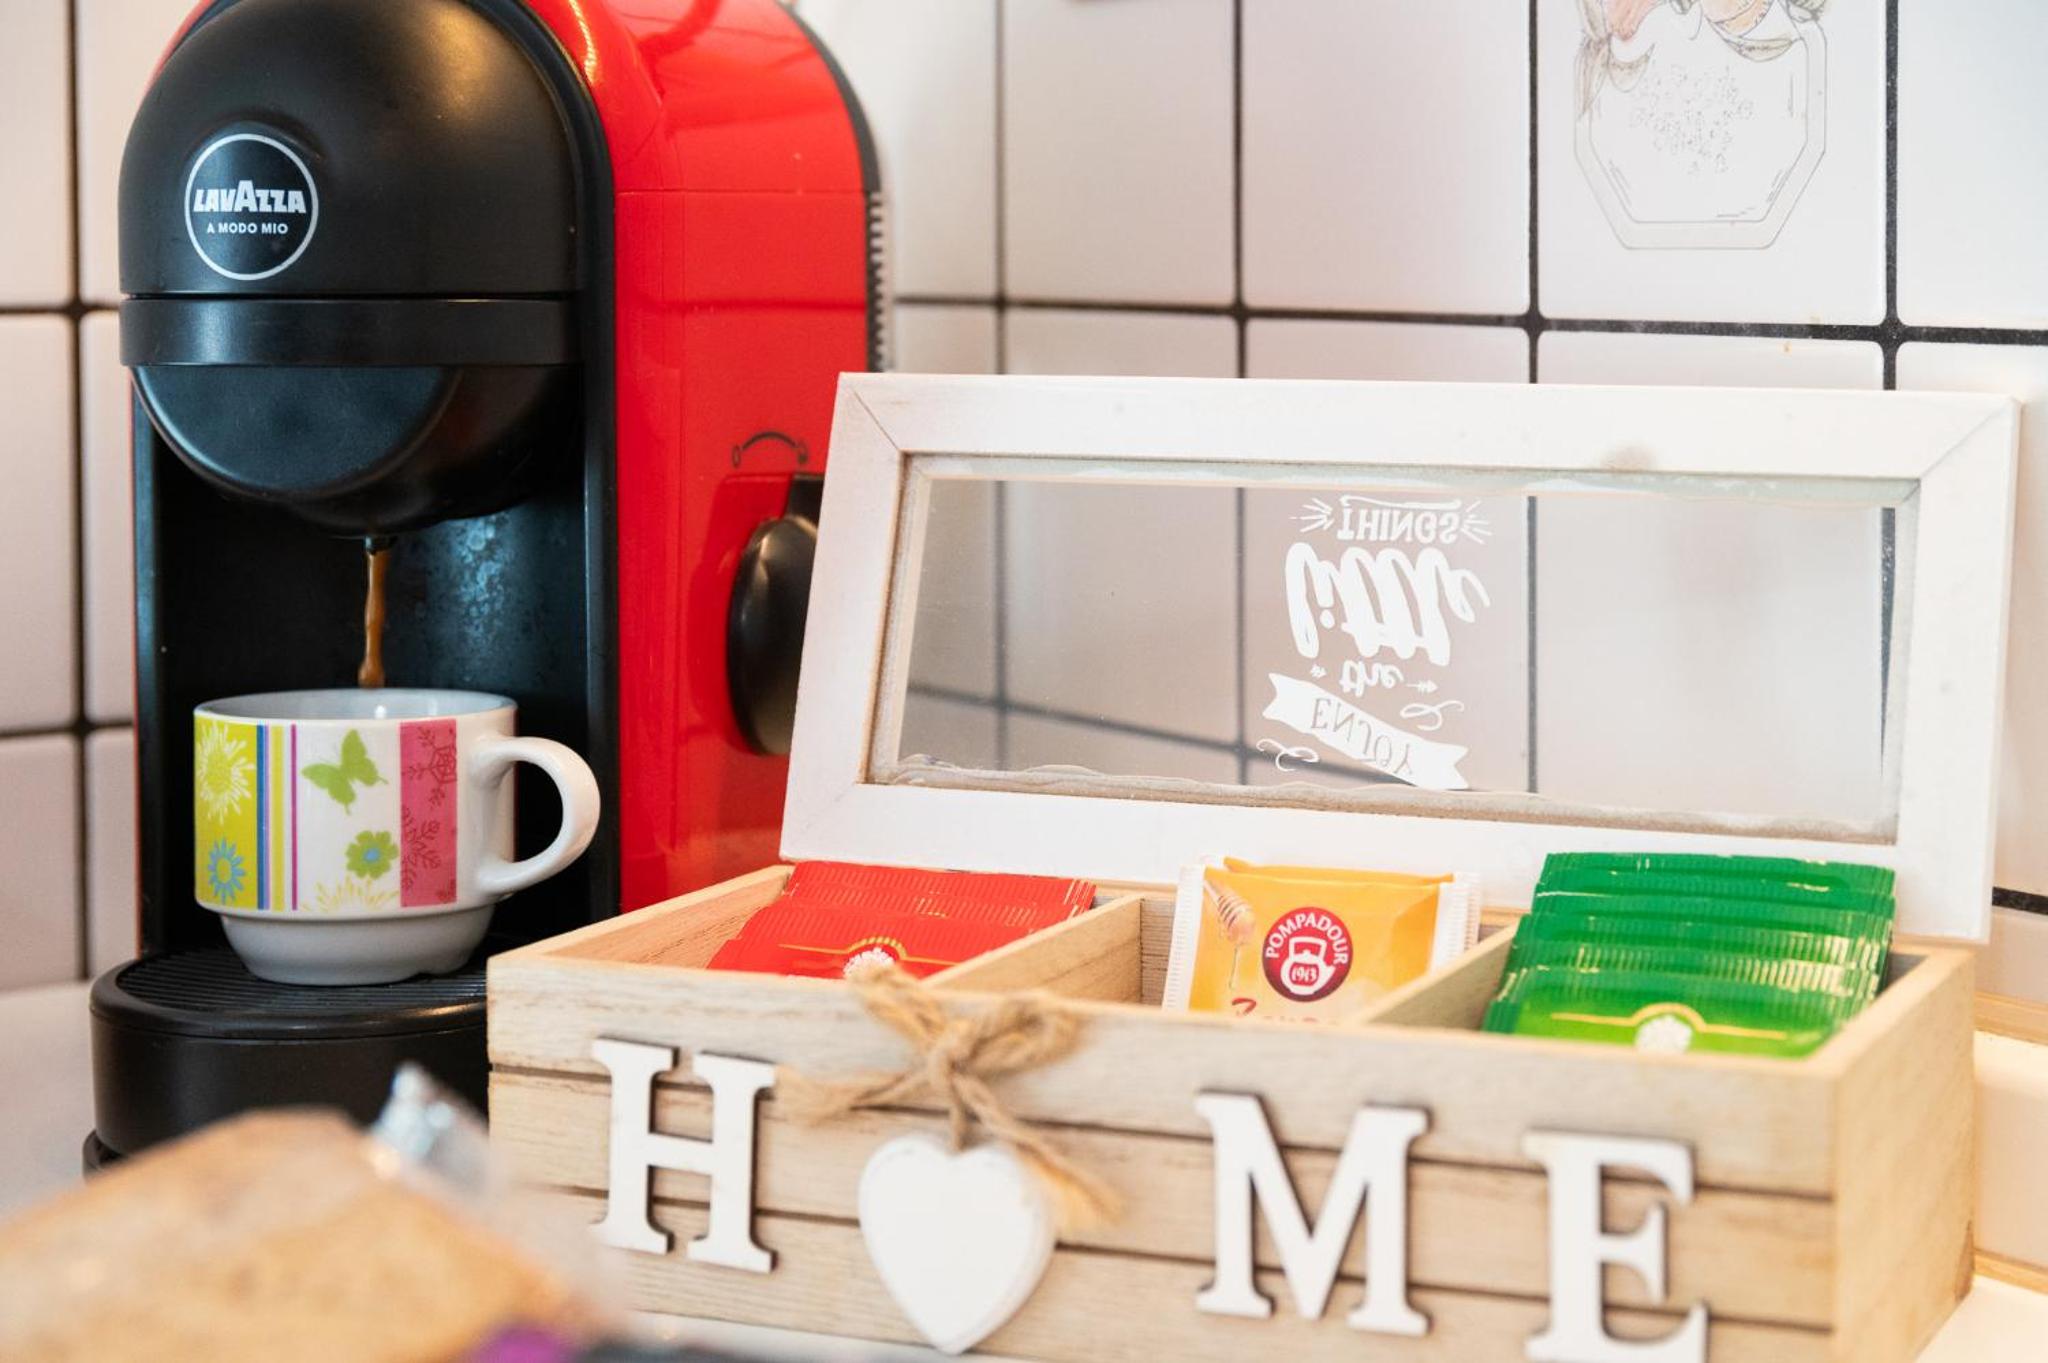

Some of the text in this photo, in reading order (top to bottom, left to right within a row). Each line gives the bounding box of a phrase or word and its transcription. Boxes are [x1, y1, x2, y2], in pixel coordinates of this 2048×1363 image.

[194, 180, 306, 213] LAVAZZA
[207, 223, 289, 234] A MODO MIO
[1265, 912, 1349, 965] POMPADOUR
